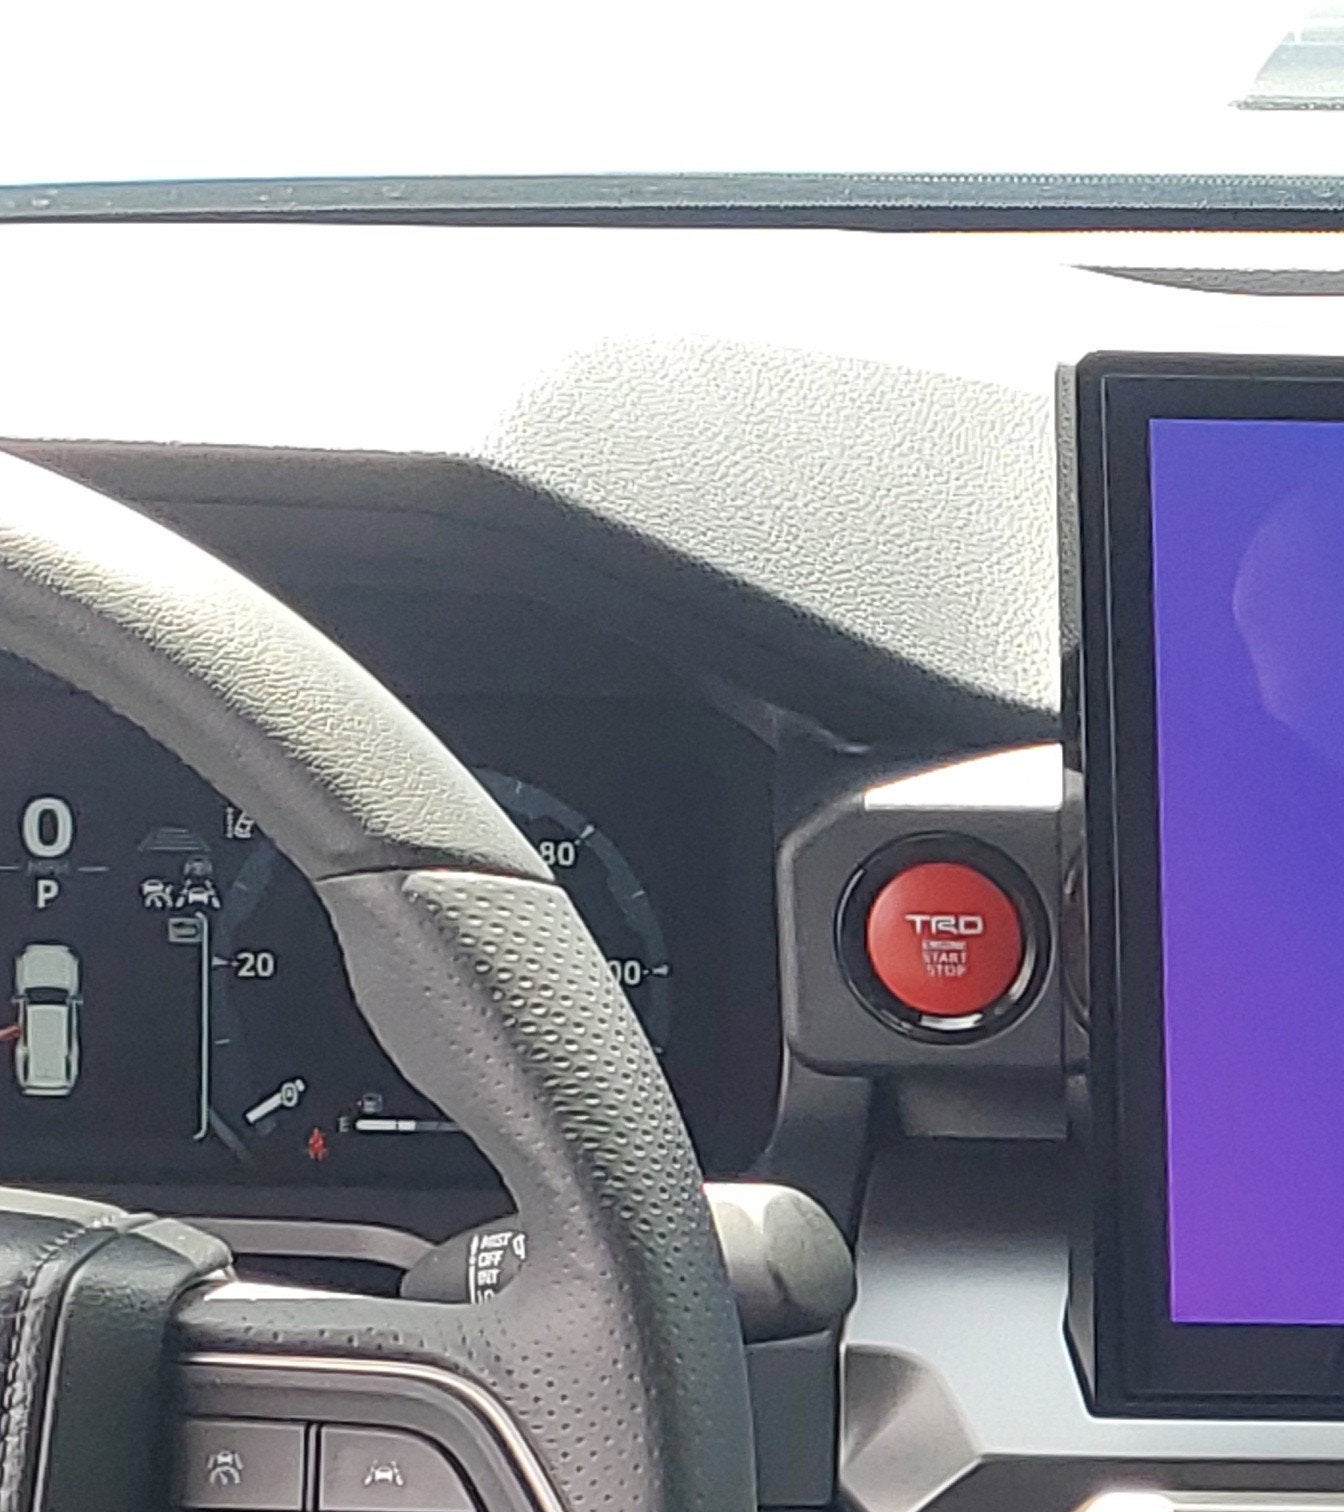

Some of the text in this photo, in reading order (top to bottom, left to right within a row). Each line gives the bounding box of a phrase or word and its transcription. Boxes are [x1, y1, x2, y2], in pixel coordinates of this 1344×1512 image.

[23, 797, 73, 857] 0
[540, 841, 576, 866] 80
[36, 879, 59, 908] P
[904, 914, 984, 935] TRD
[236, 951, 275, 977] 20
[607, 959, 641, 985] 00
[926, 964, 966, 977] STOP
